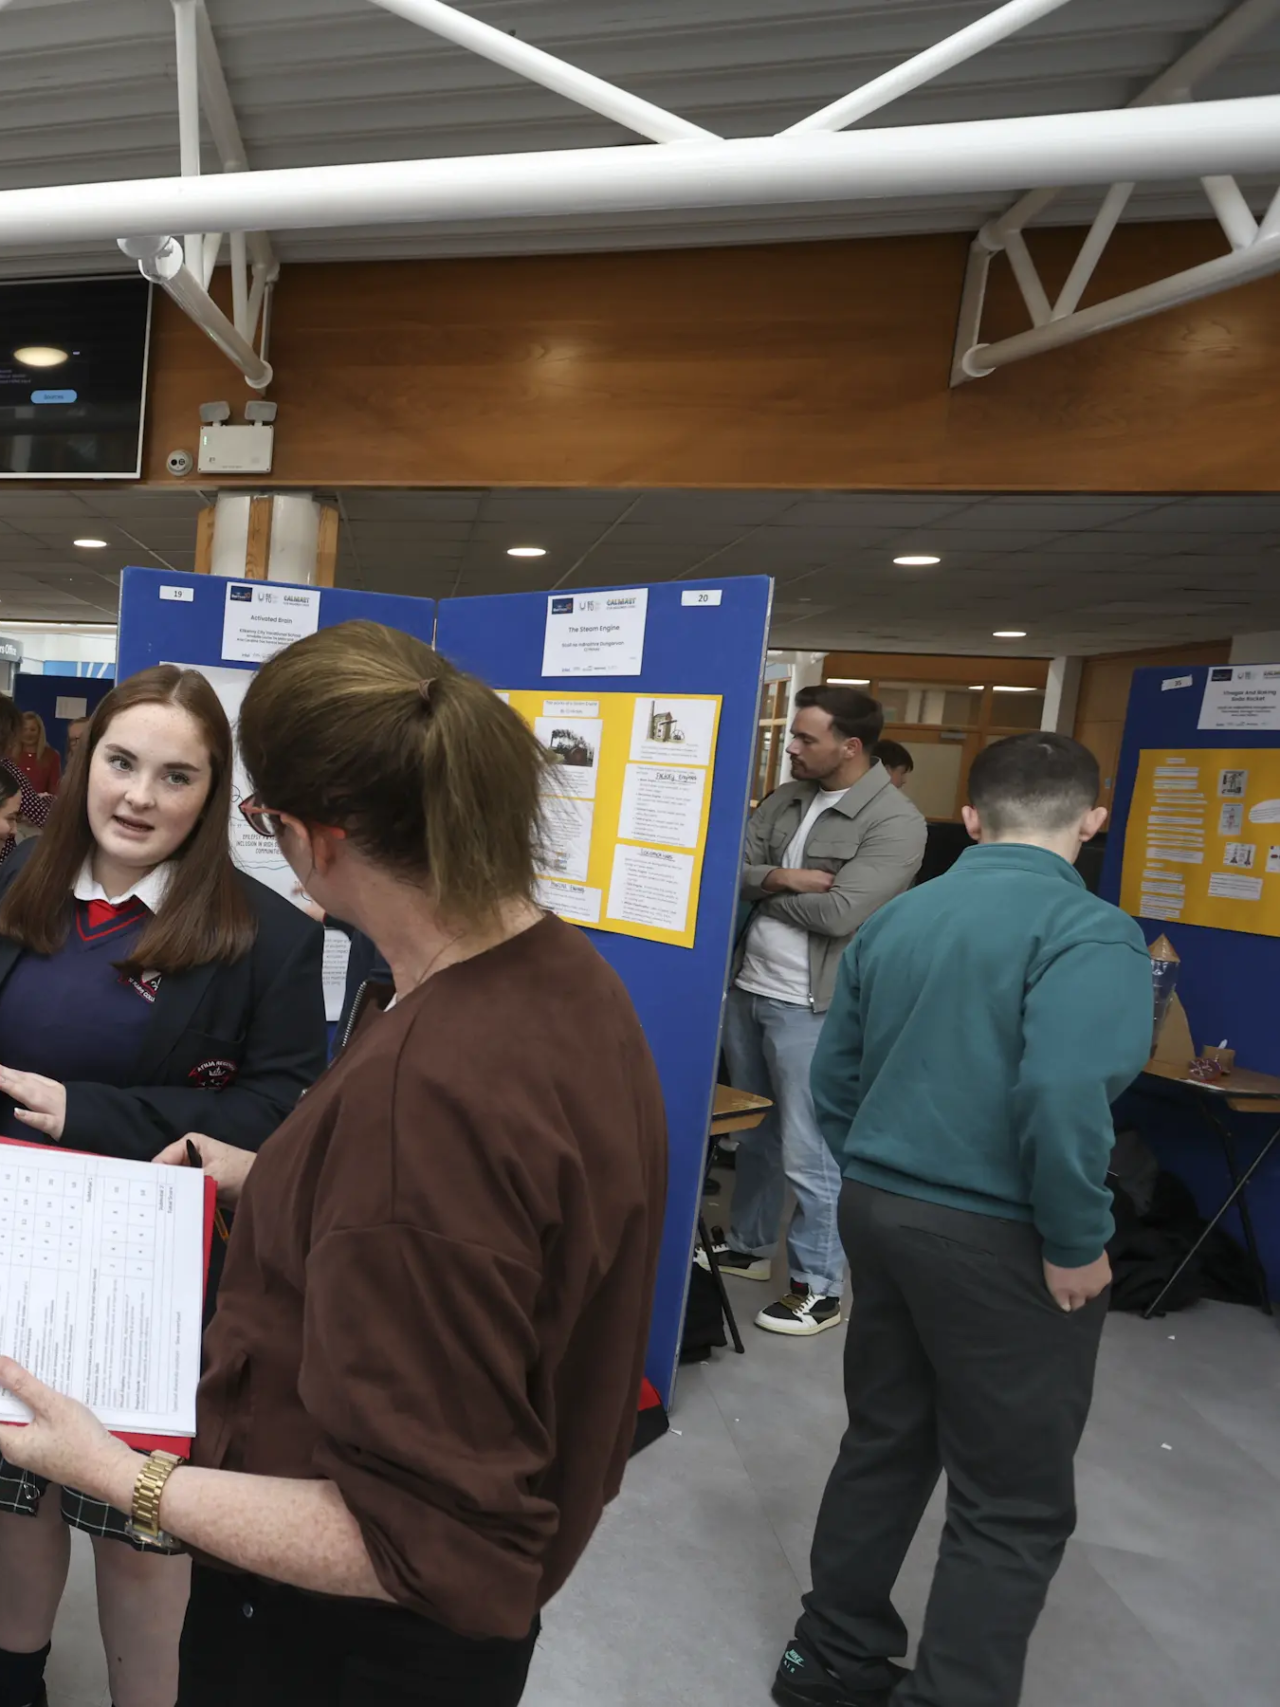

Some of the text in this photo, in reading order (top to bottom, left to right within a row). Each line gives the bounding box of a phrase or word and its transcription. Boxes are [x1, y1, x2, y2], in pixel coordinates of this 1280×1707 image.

[174, 590, 182, 598] 19
[698, 594, 708, 602] 20
[250, 614, 292, 624] Activated Brain
[600, 624, 620, 633] Engine
